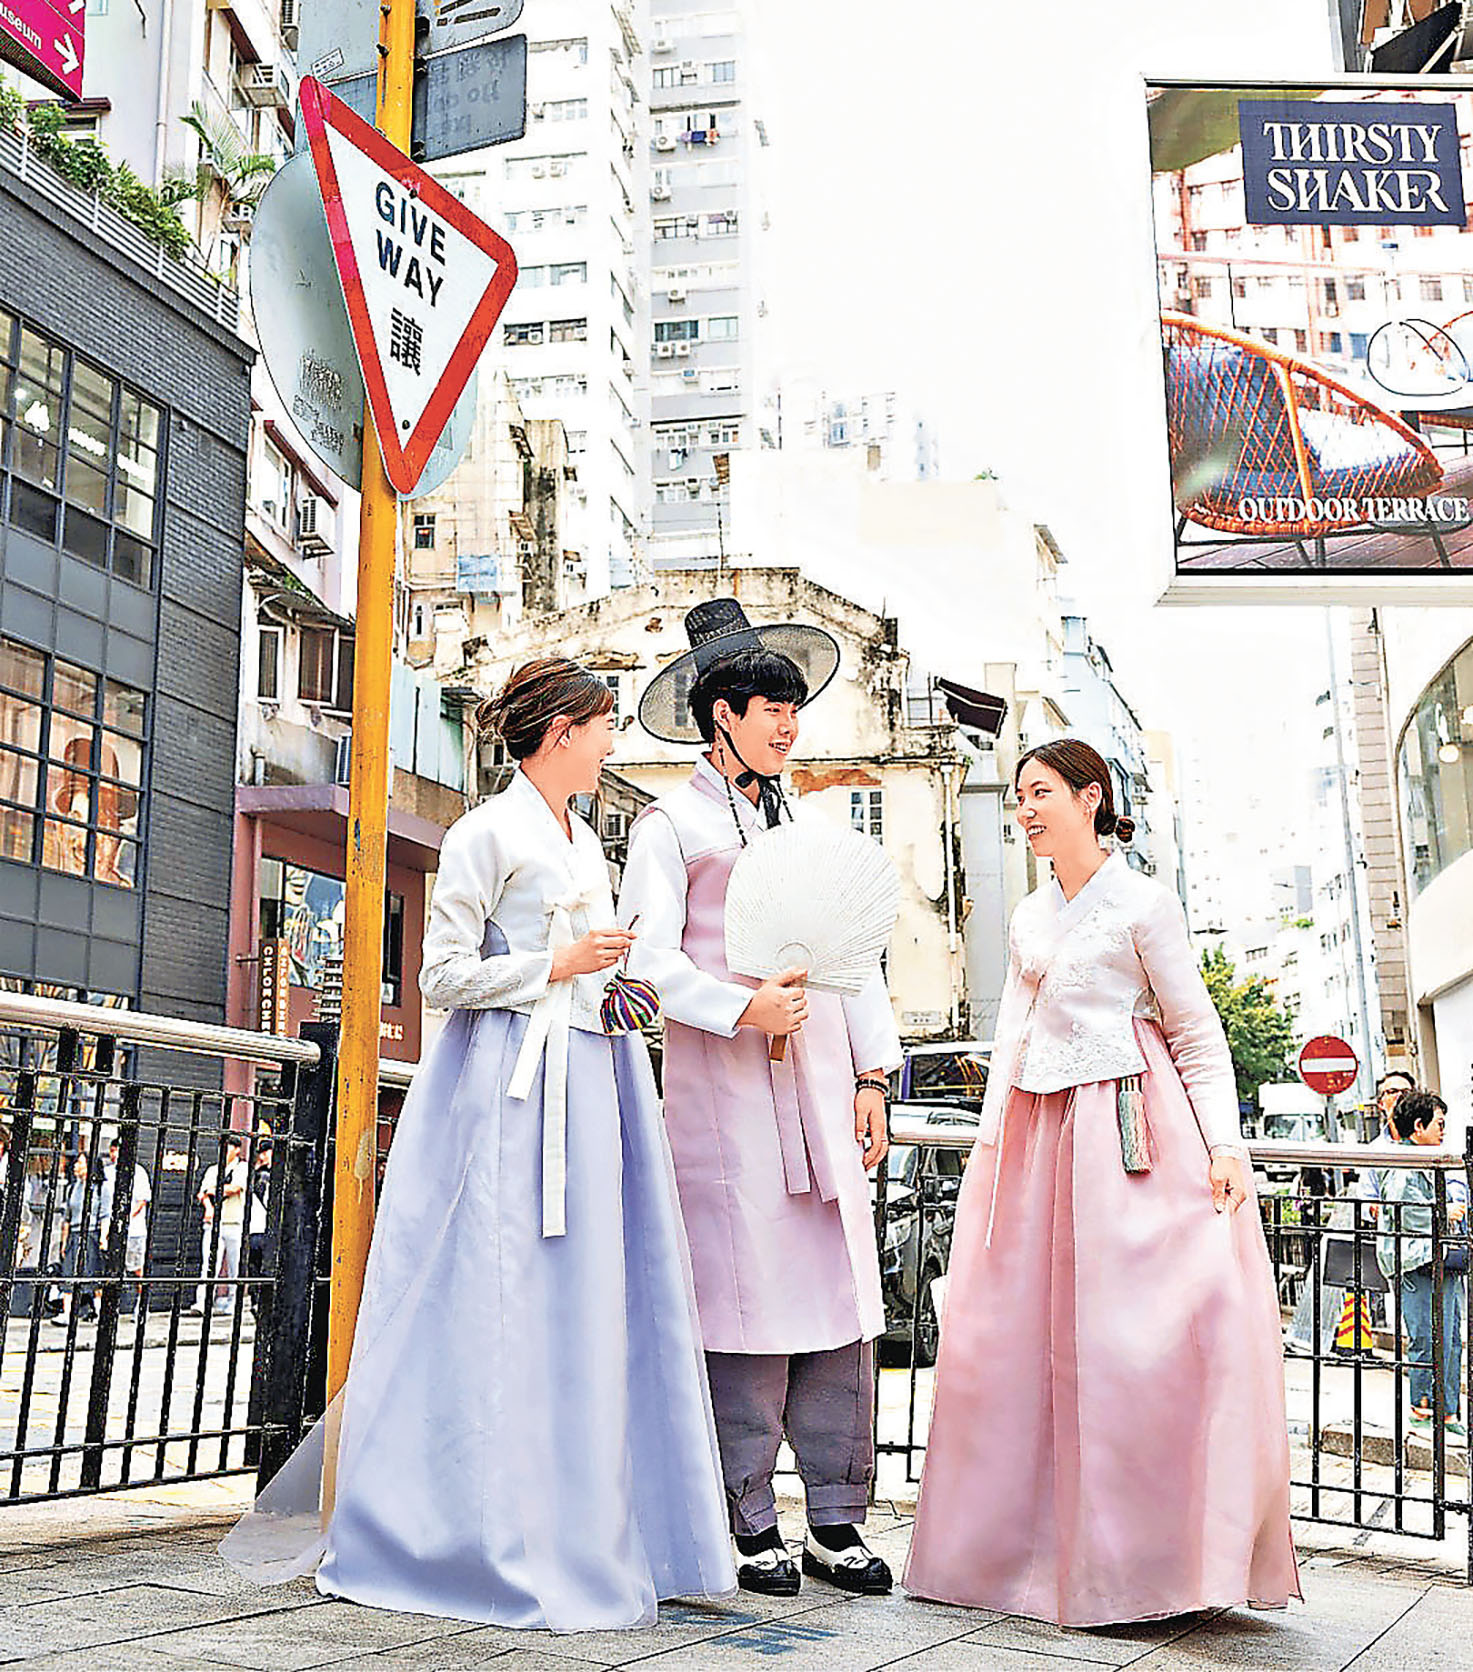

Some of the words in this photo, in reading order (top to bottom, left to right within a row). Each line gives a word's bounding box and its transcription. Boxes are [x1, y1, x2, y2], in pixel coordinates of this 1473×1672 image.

[1263, 122, 1443, 165] THIRSTY
[1267, 168, 1450, 213] SHAKER
[375, 181, 446, 266] GIVE
[376, 229, 443, 307] WAY
[390, 307, 423, 376] 讓
[1238, 497, 1361, 522] OUTDOOR
[1363, 497, 1470, 522] TERRACE
